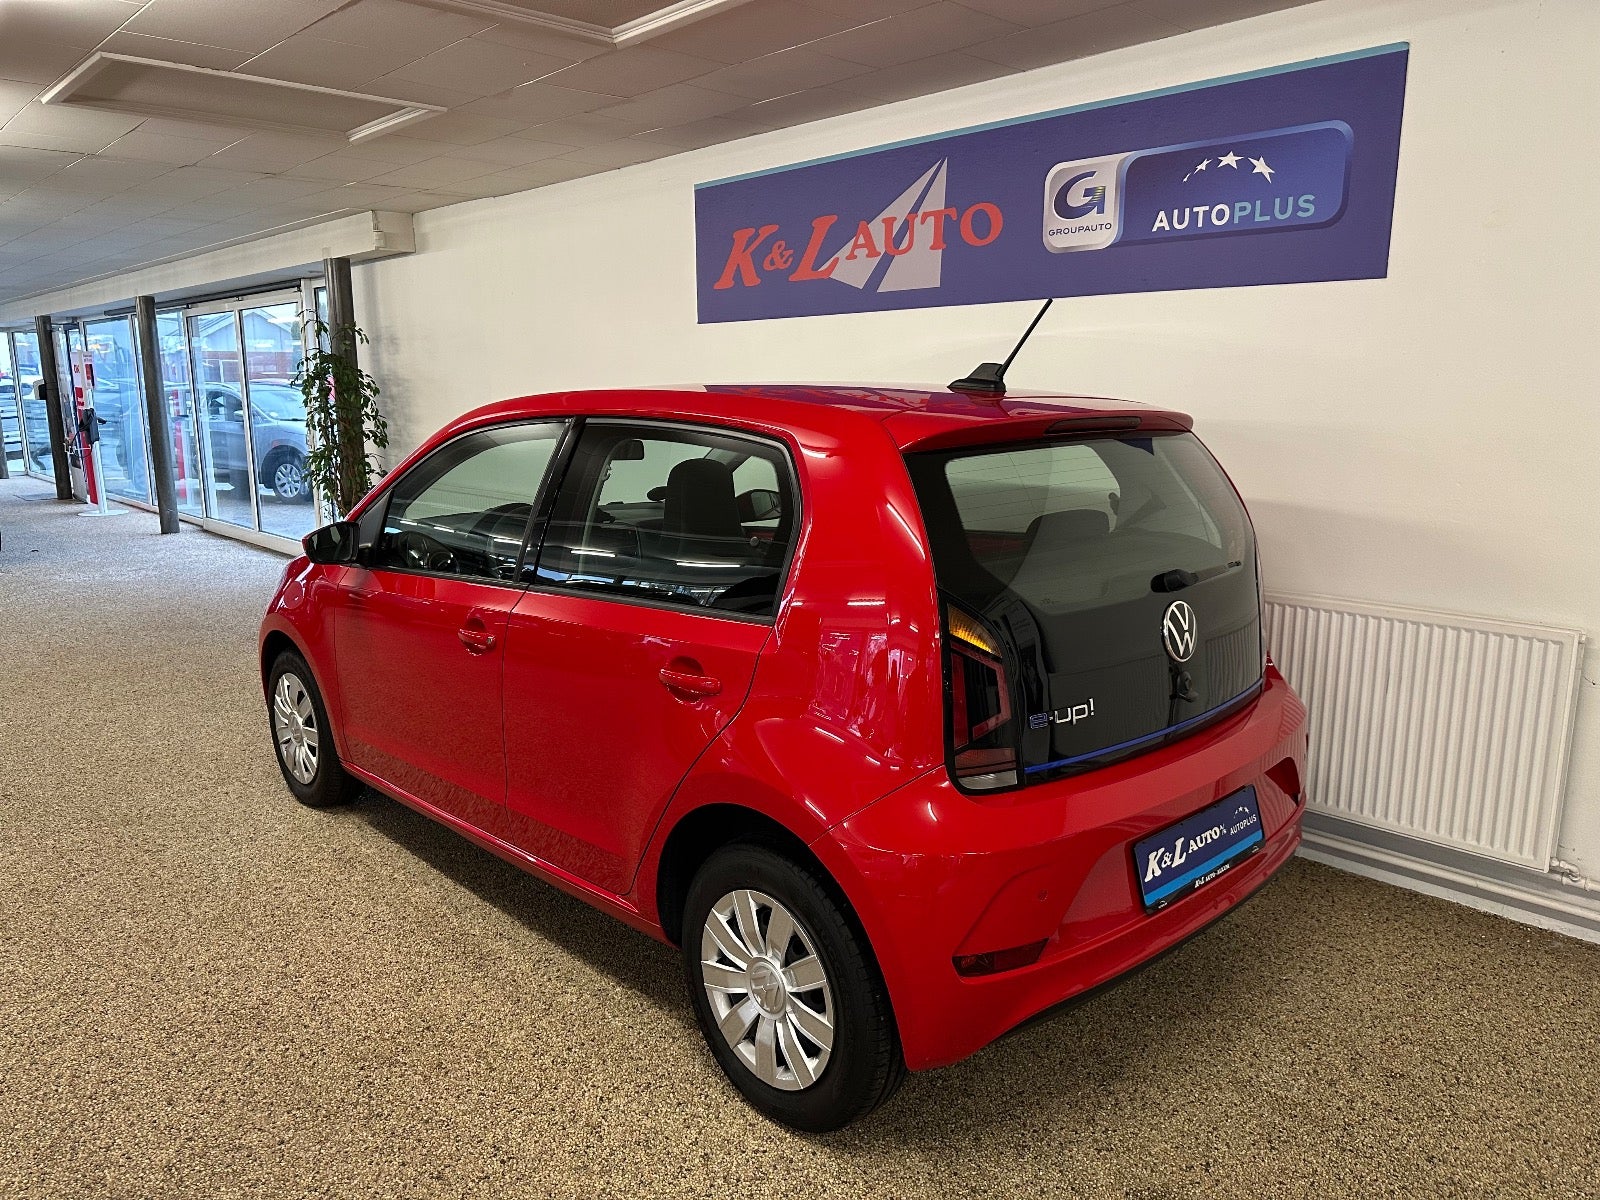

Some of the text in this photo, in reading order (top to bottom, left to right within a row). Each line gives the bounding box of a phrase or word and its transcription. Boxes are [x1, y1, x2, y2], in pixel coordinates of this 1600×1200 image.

[1048, 222, 1112, 236] GROUPAUTO
[1151, 193, 1316, 233] AUTOPLUS
[713, 203, 1003, 290] K&L AUTO
[1230, 814, 1257, 836] AUTOPLUS
[1144, 837, 1187, 882] K&L
[1188, 826, 1220, 853] AUTO
